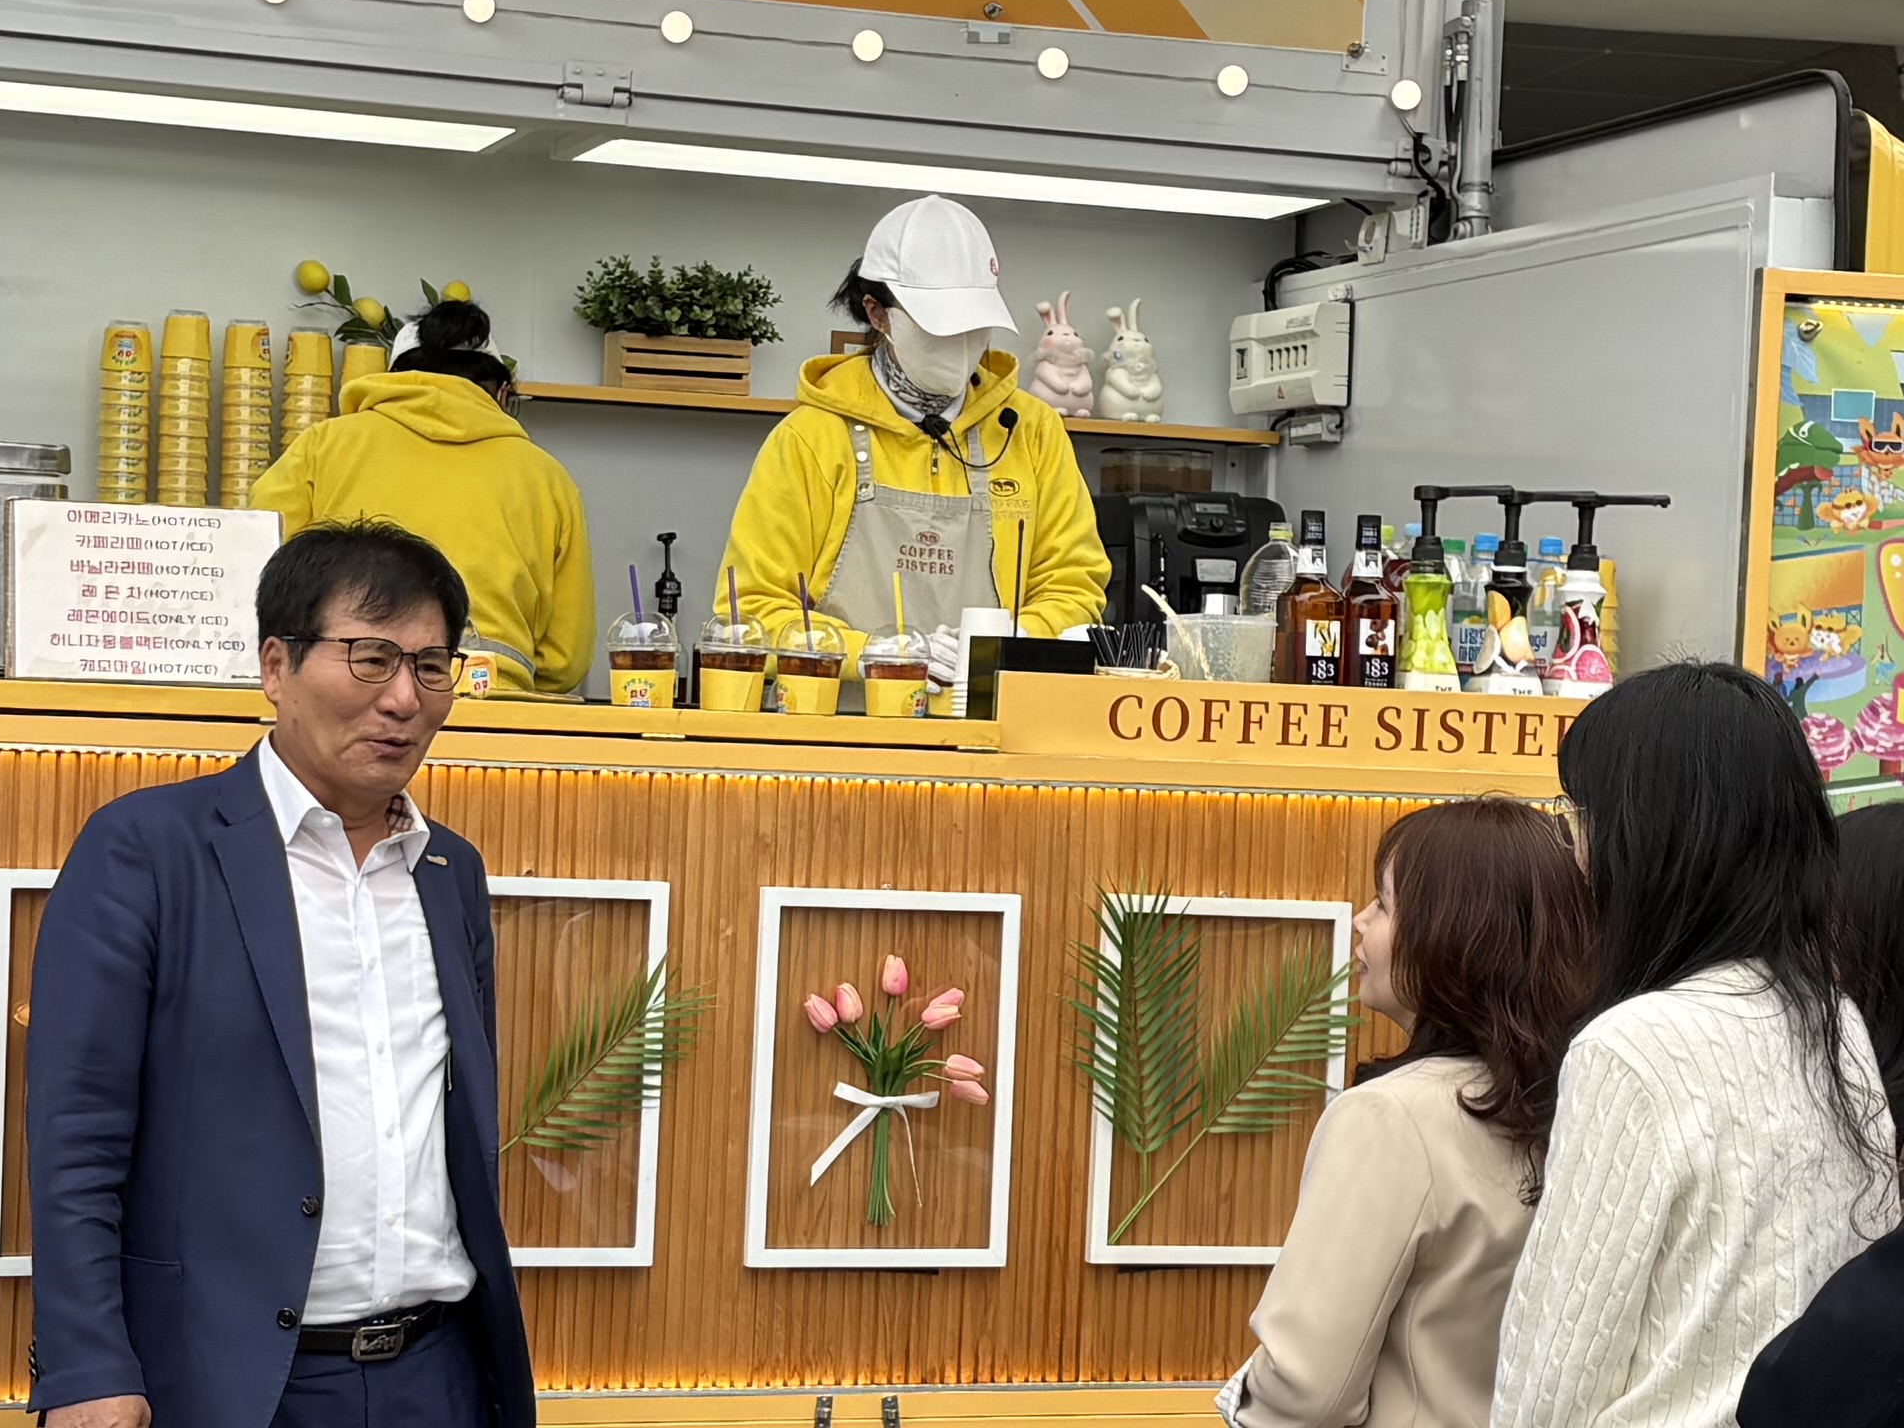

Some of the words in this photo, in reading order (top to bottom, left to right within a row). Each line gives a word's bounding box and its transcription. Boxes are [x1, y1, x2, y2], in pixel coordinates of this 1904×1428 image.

[899, 543, 954, 561] COFFEE
[896, 558, 954, 575] SISTERS
[1107, 694, 1350, 750] COFFEE
[1375, 705, 1576, 759] SISTE
